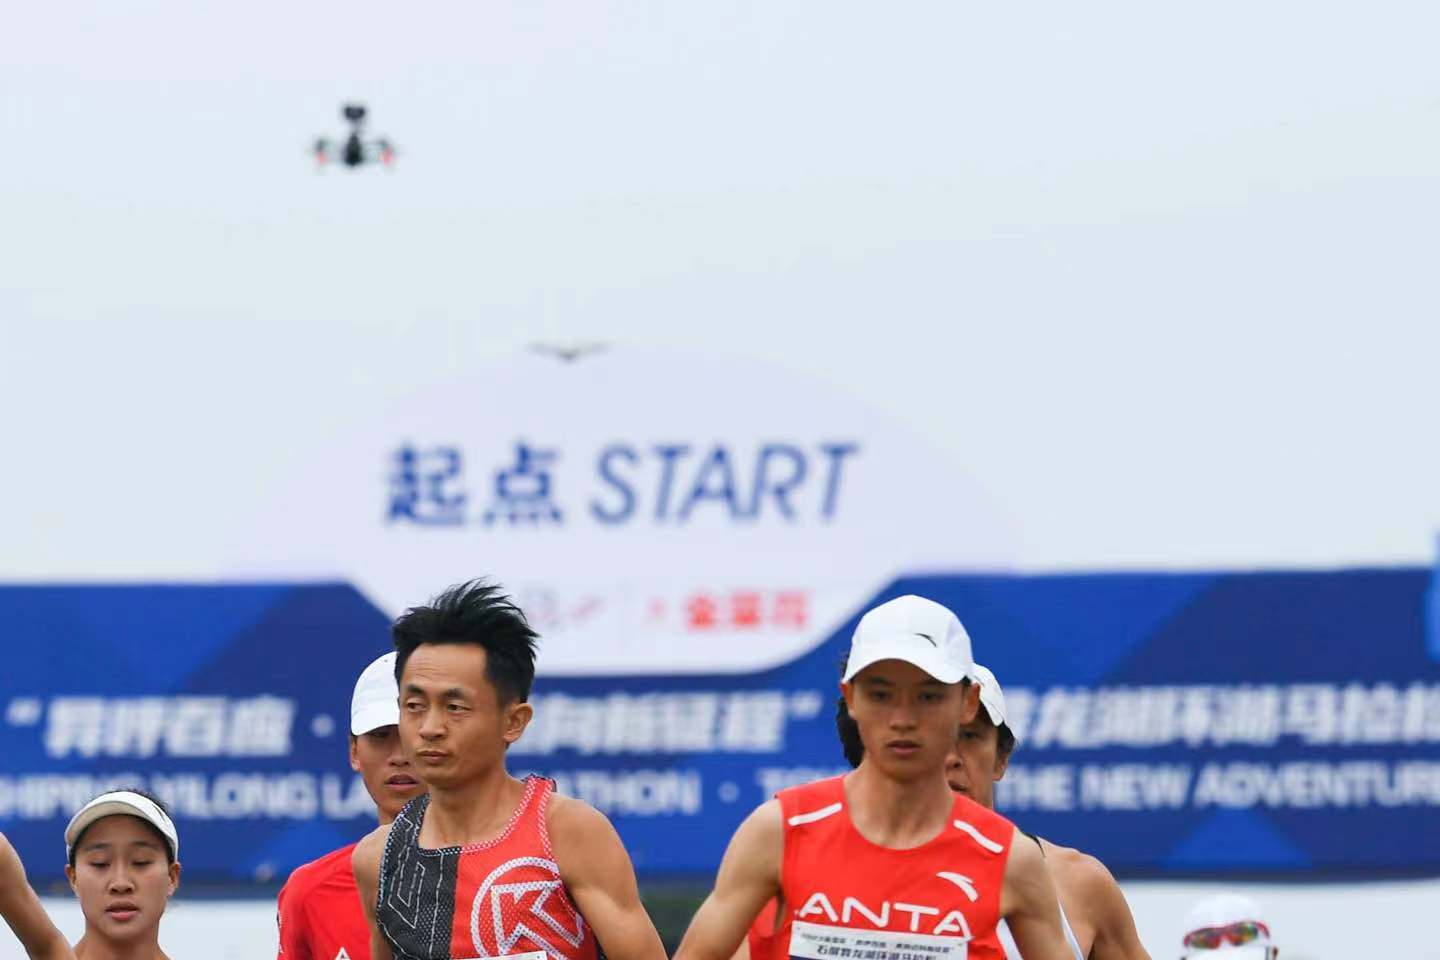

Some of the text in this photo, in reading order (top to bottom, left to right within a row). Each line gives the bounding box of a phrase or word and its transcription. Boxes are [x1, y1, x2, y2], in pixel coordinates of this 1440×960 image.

[385, 438, 859, 527] 起点 START
[799, 892, 974, 938] ANTA
